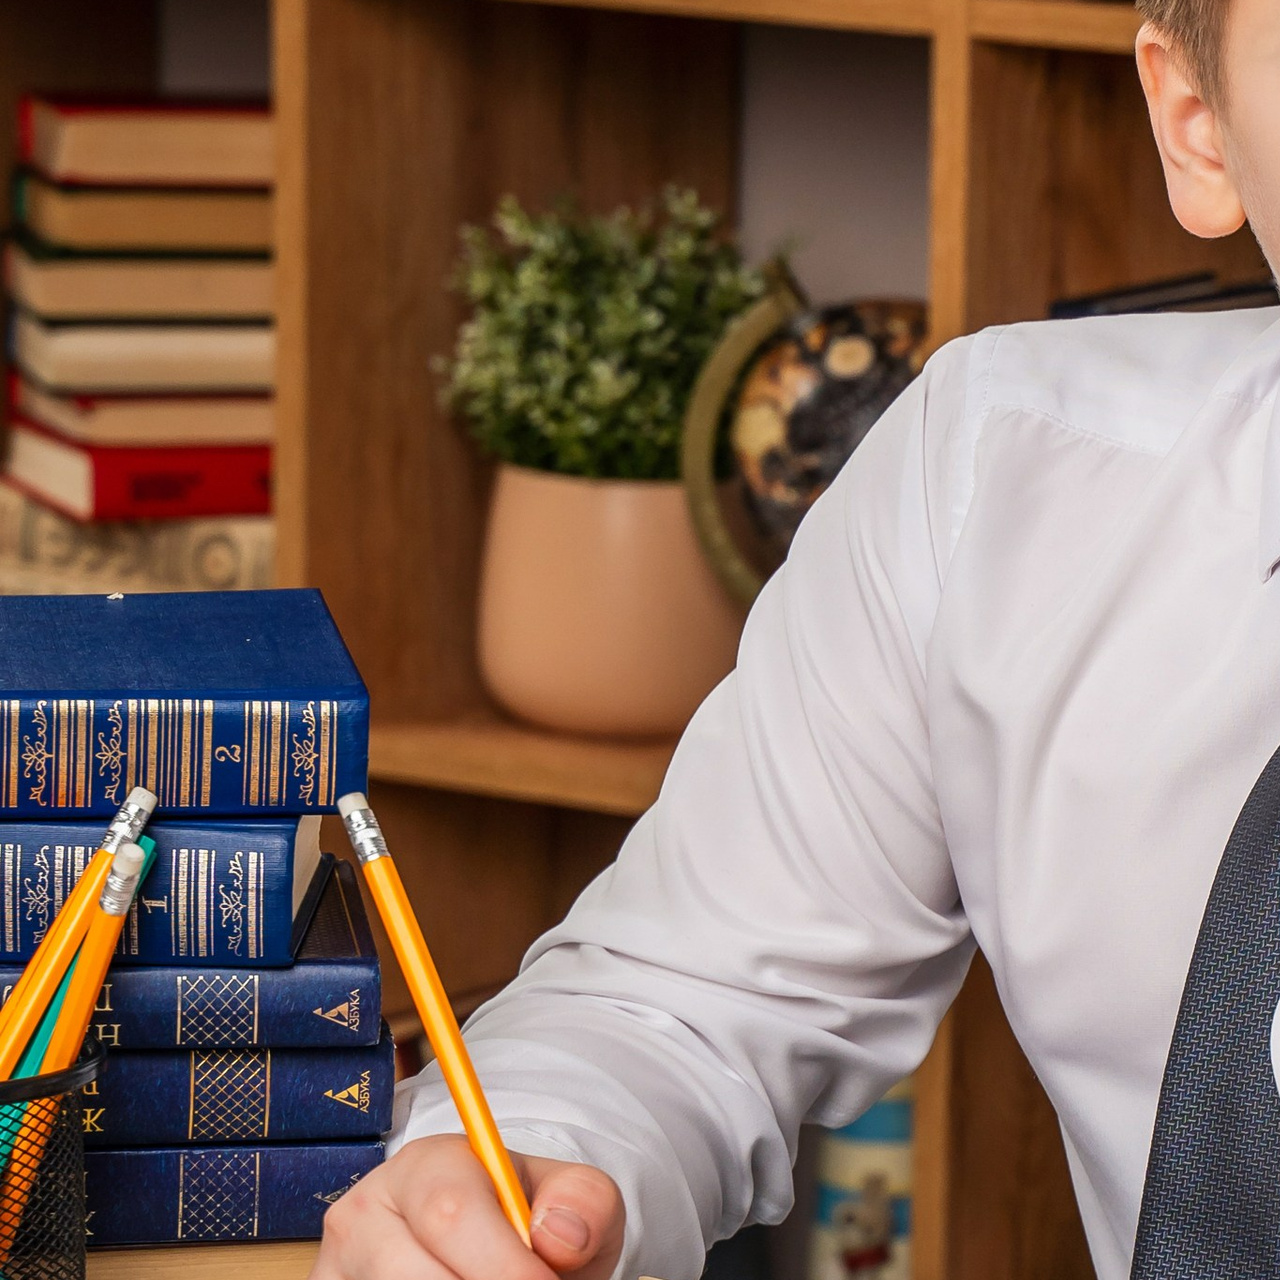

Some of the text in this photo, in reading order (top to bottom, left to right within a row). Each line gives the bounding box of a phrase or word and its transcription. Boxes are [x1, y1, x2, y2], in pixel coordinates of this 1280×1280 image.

[214, 744, 242, 763] 2
[348, 988, 361, 1032] АЗБУКА
[358, 1070, 371, 1114] АЗБУКА
